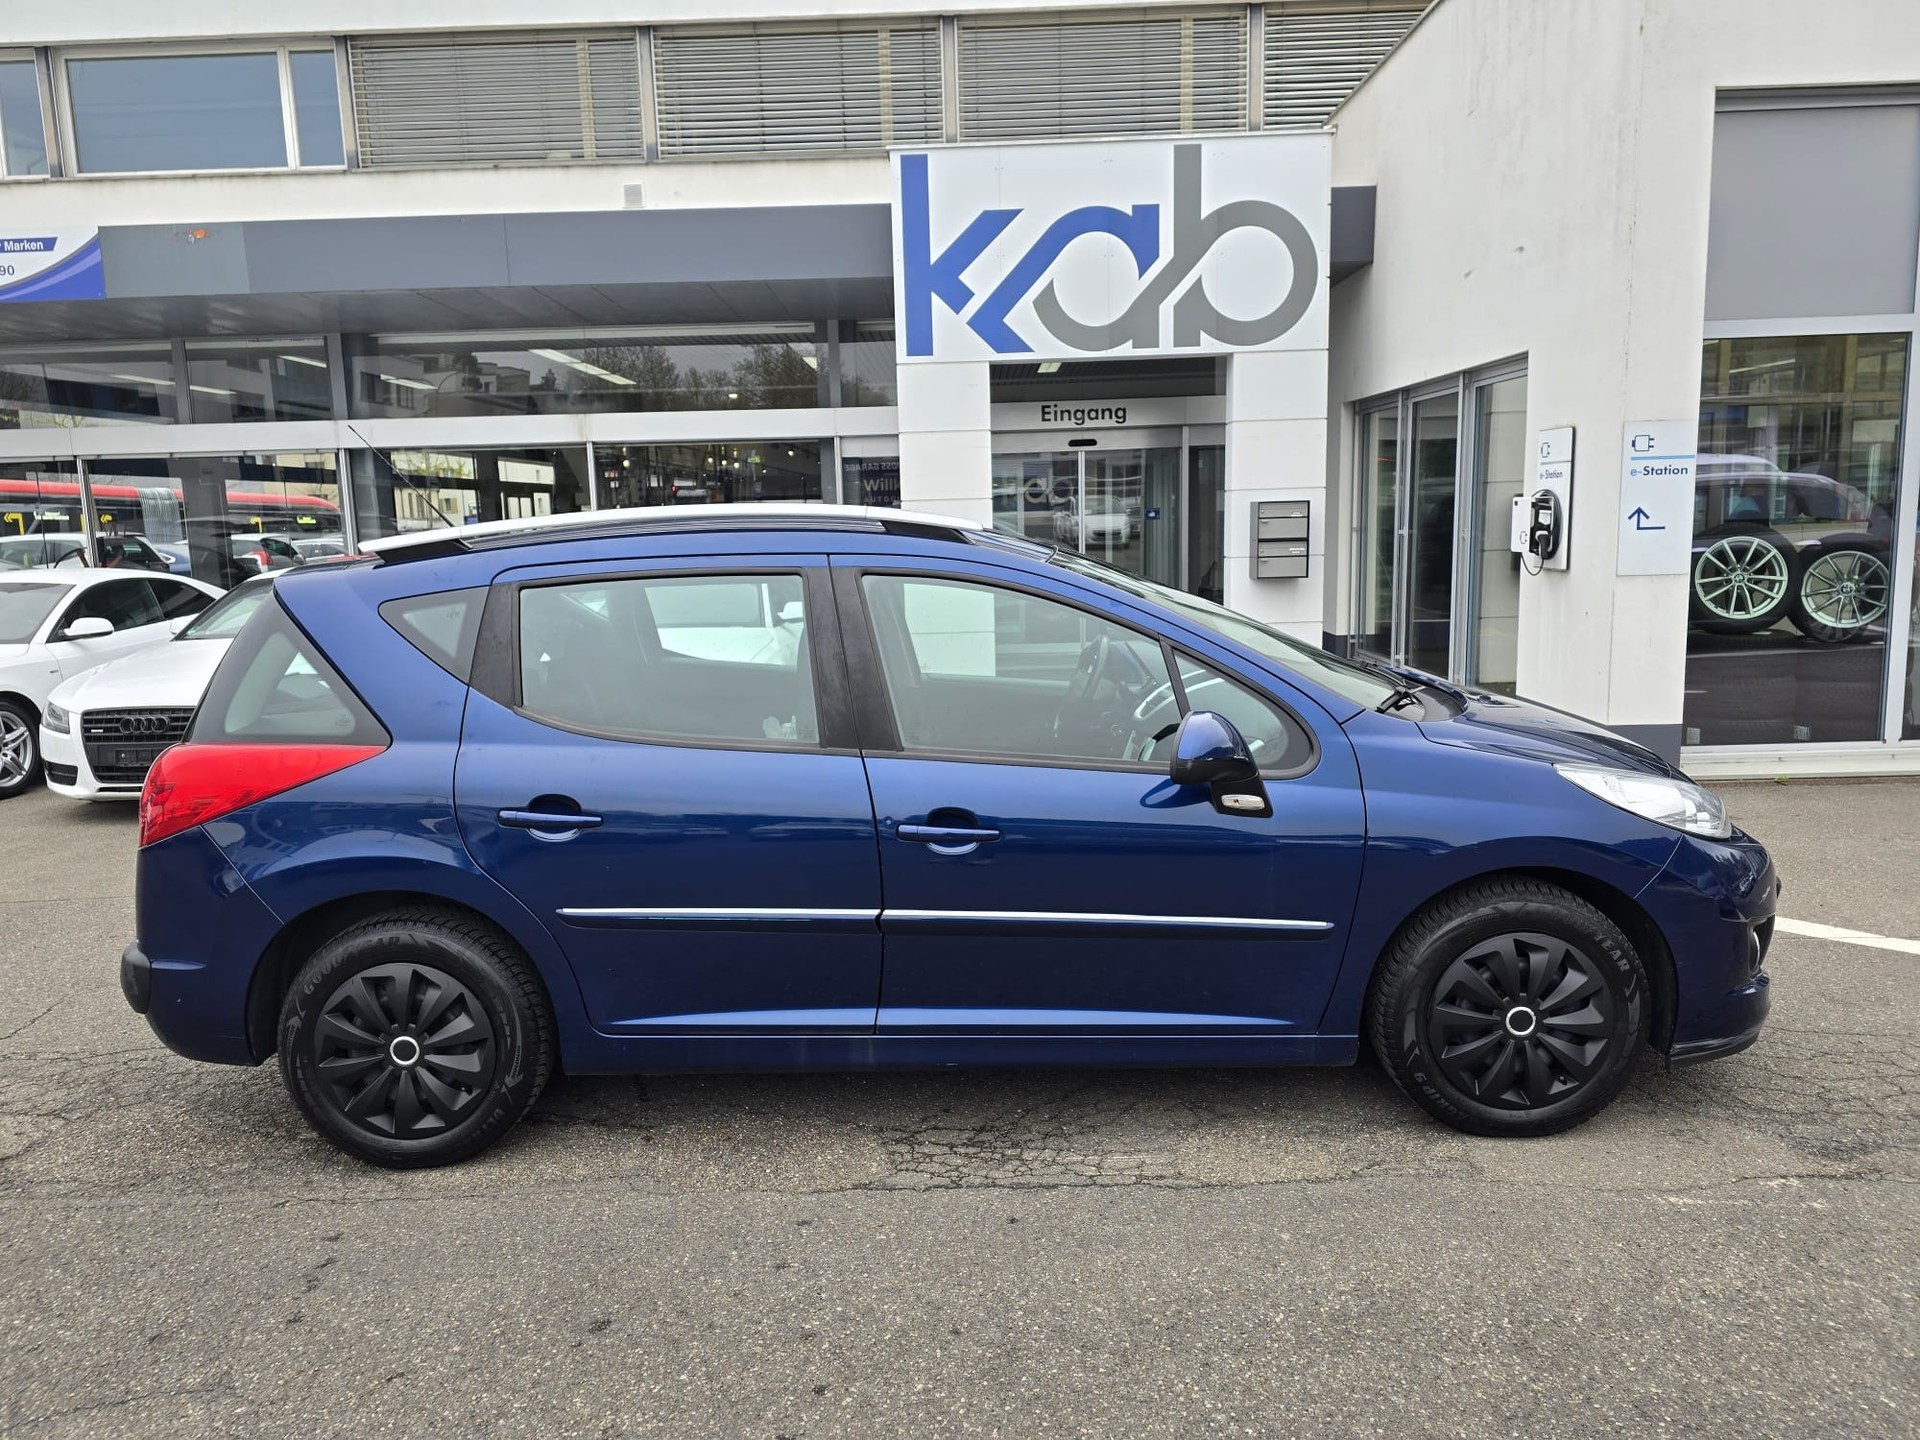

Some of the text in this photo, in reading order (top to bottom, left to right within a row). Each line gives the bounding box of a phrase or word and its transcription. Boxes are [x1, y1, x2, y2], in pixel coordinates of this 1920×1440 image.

[4, 240, 44, 252] Marken
[900, 143, 1318, 356] kab
[1041, 404, 1127, 426] Eingang
[1539, 469, 1563, 480] e-Station
[1630, 465, 1688, 477] e-Station
